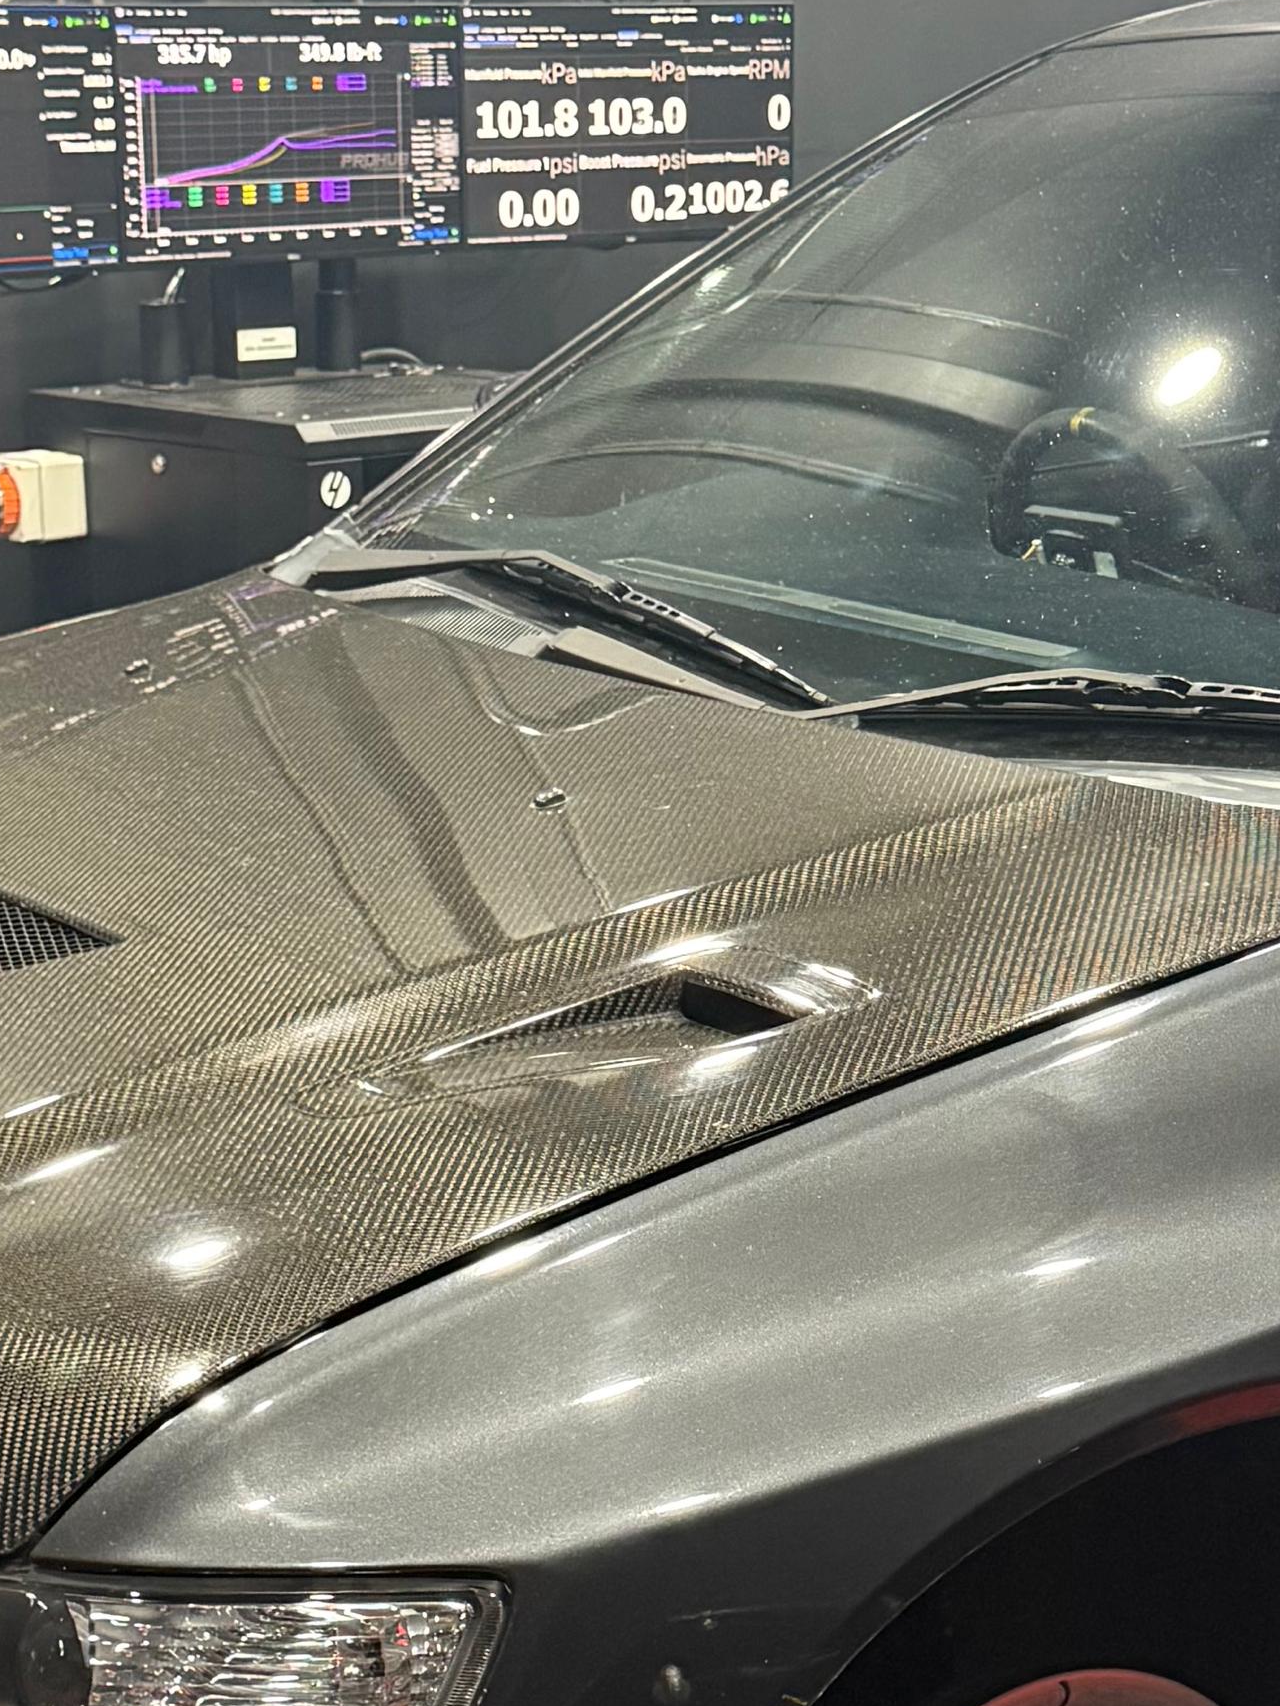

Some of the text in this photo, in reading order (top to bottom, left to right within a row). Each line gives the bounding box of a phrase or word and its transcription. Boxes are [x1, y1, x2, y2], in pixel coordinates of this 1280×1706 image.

[208, 43, 232, 68] hp
[541, 62, 577, 84] kPa
[651, 60, 686, 82] kPa
[748, 58, 790, 80] RPM
[476, 98, 579, 139] 101.8
[588, 96, 687, 135] 103.0
[767, 93, 791, 130] 0
[550, 152, 578, 179] psi
[659, 149, 686, 175] psi
[755, 145, 790, 166] hPa
[498, 188, 580, 229] 0.00
[631, 184, 688, 223] 0.2
